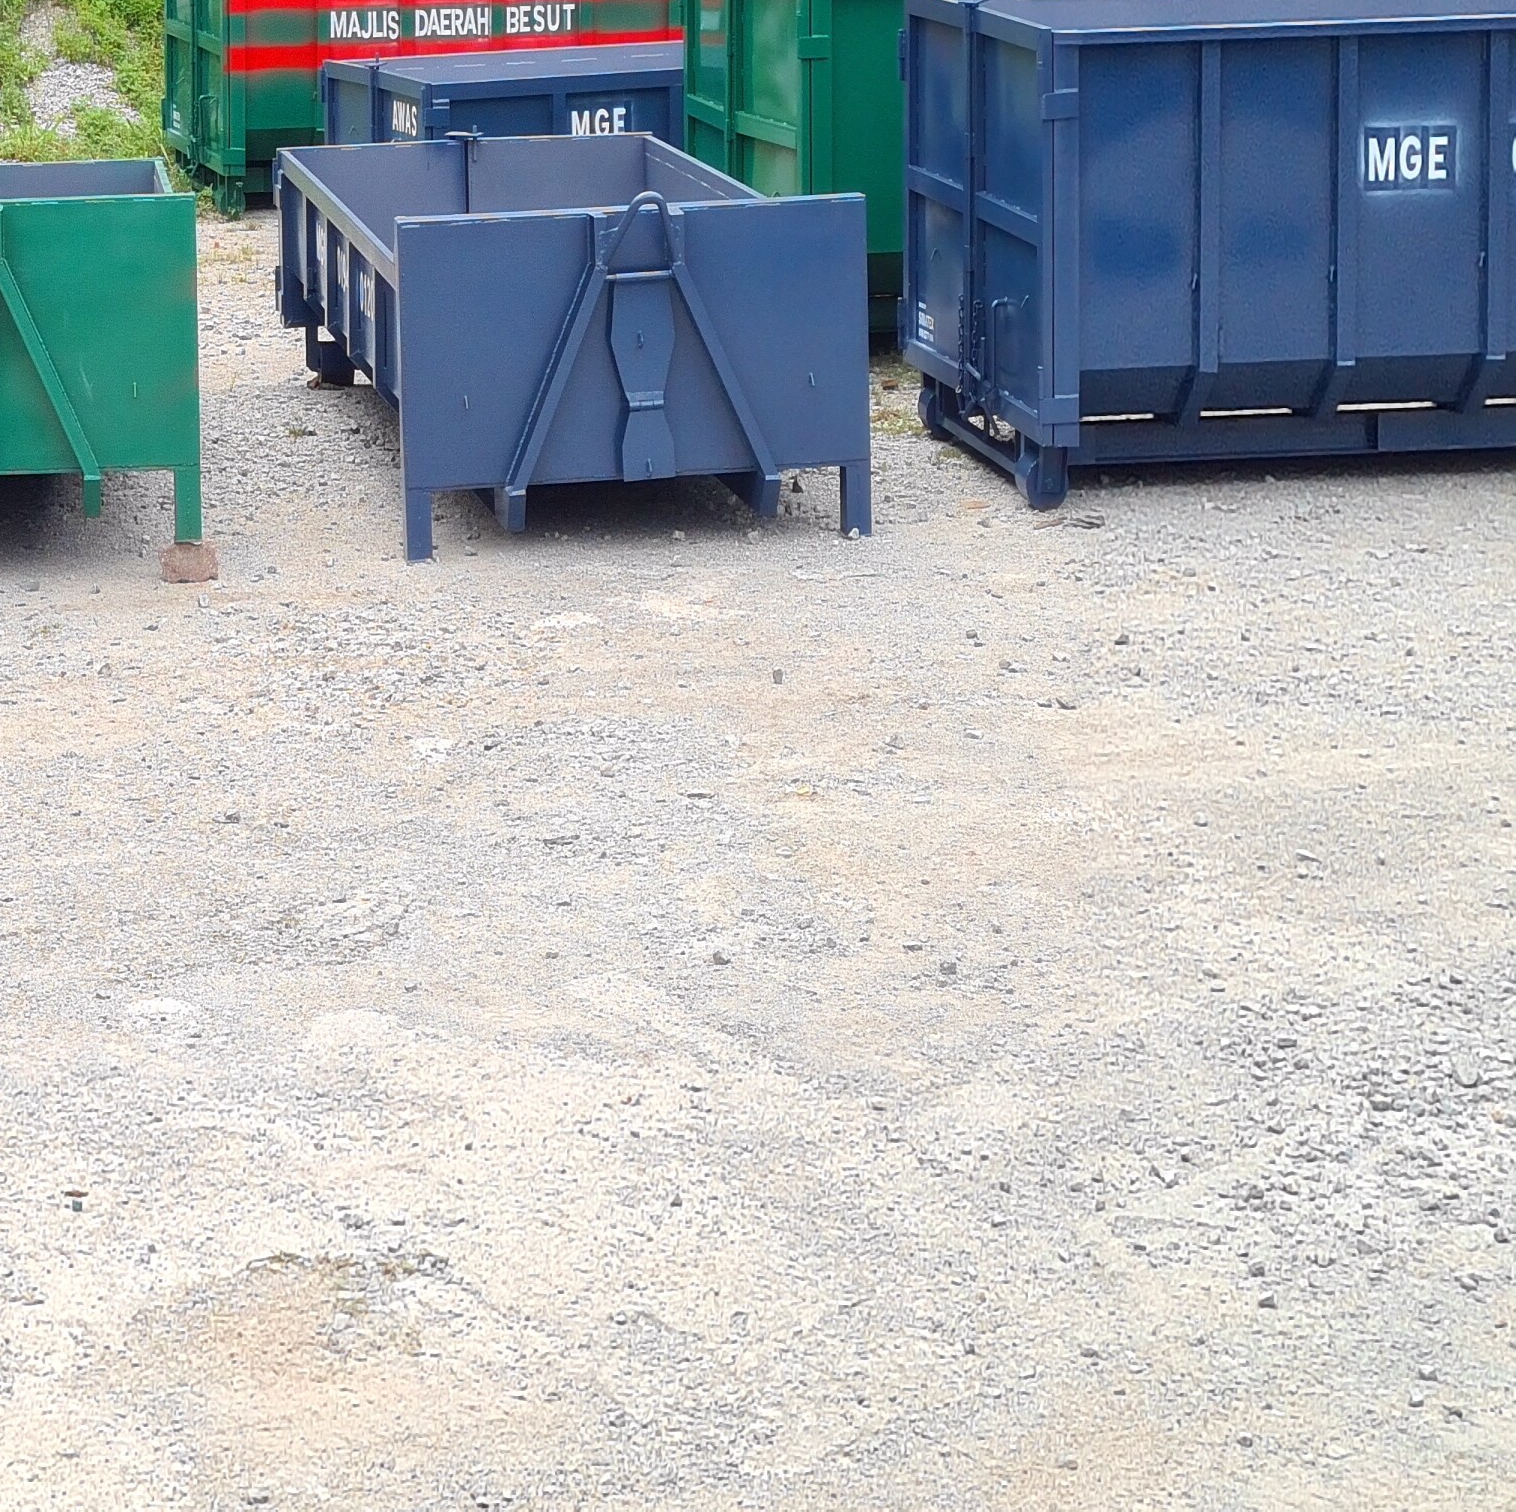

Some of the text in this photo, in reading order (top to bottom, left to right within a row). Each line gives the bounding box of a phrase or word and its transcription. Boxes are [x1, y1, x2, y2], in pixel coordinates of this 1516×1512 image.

[329, 3, 576, 40] MAJLIS DAERAH BESUT
[391, 99, 418, 137] AWAS
[1367, 134, 1449, 182] MGE
